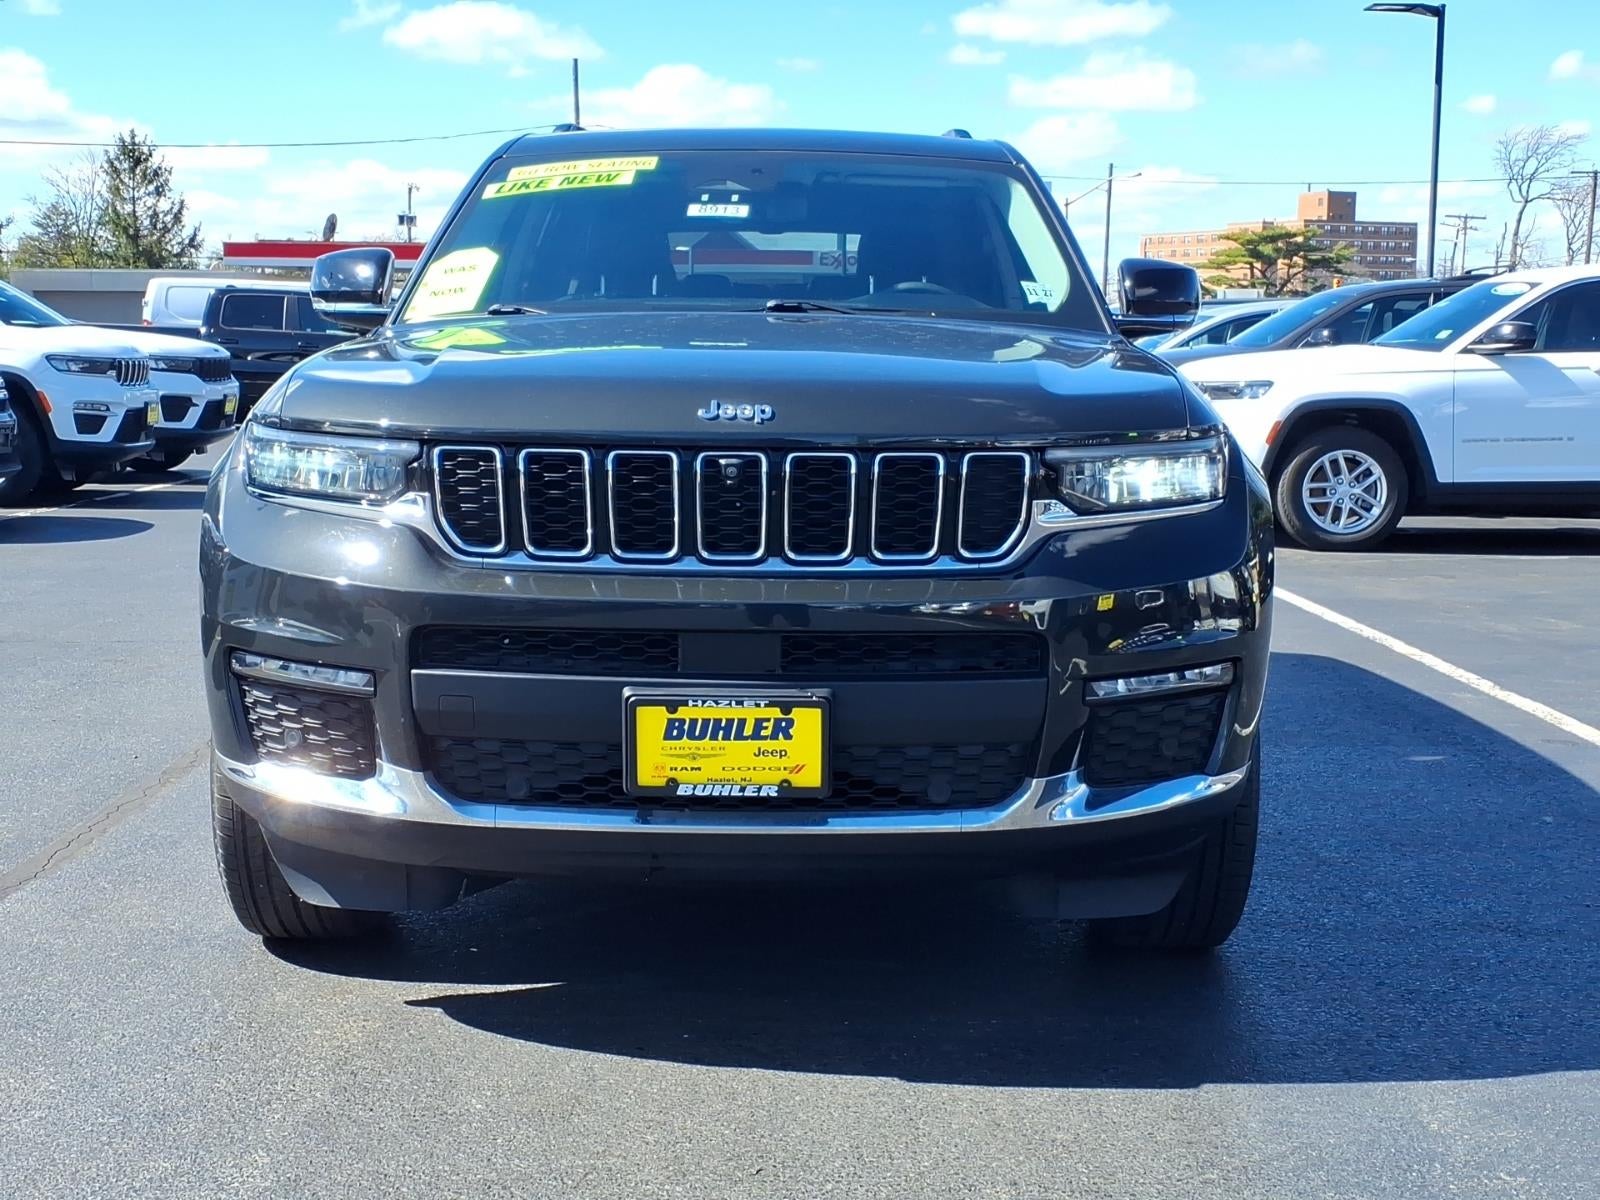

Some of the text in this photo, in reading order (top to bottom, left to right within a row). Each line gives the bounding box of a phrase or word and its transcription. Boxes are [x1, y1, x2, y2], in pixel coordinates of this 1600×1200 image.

[494, 179, 552, 194] LIKE
[557, 172, 621, 187] NEW
[443, 265, 478, 274] WAS
[429, 287, 466, 297] NOW
[697, 399, 776, 424] Jeep
[688, 700, 769, 708] HAZLET
[662, 717, 795, 742] BUHLER
[753, 747, 788, 759] Jeep
[676, 784, 779, 797] BUHLER
